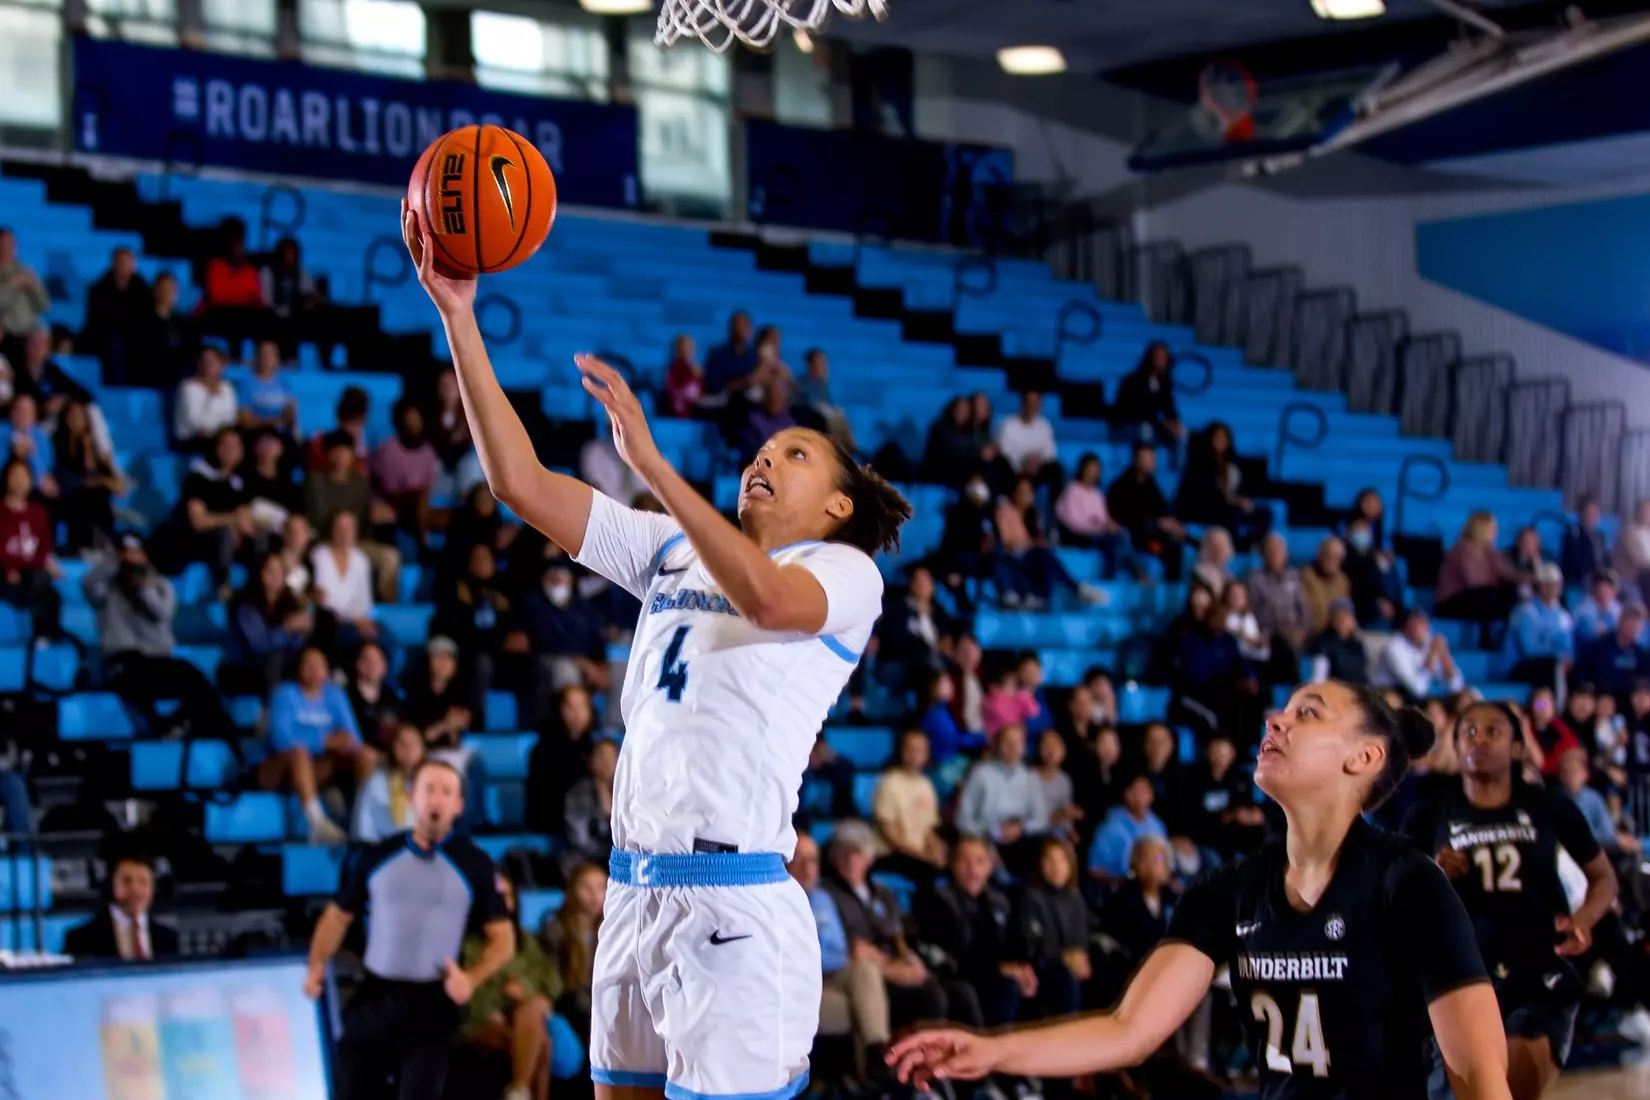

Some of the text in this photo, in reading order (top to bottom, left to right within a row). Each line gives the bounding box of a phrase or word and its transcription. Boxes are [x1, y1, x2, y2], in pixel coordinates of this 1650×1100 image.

[441, 153, 467, 235] ELITE
[656, 625, 692, 702] 4
[1472, 845, 1522, 892] 12
[1238, 955, 1348, 981] VANDERBILT
[1251, 990, 1331, 1078] 24
